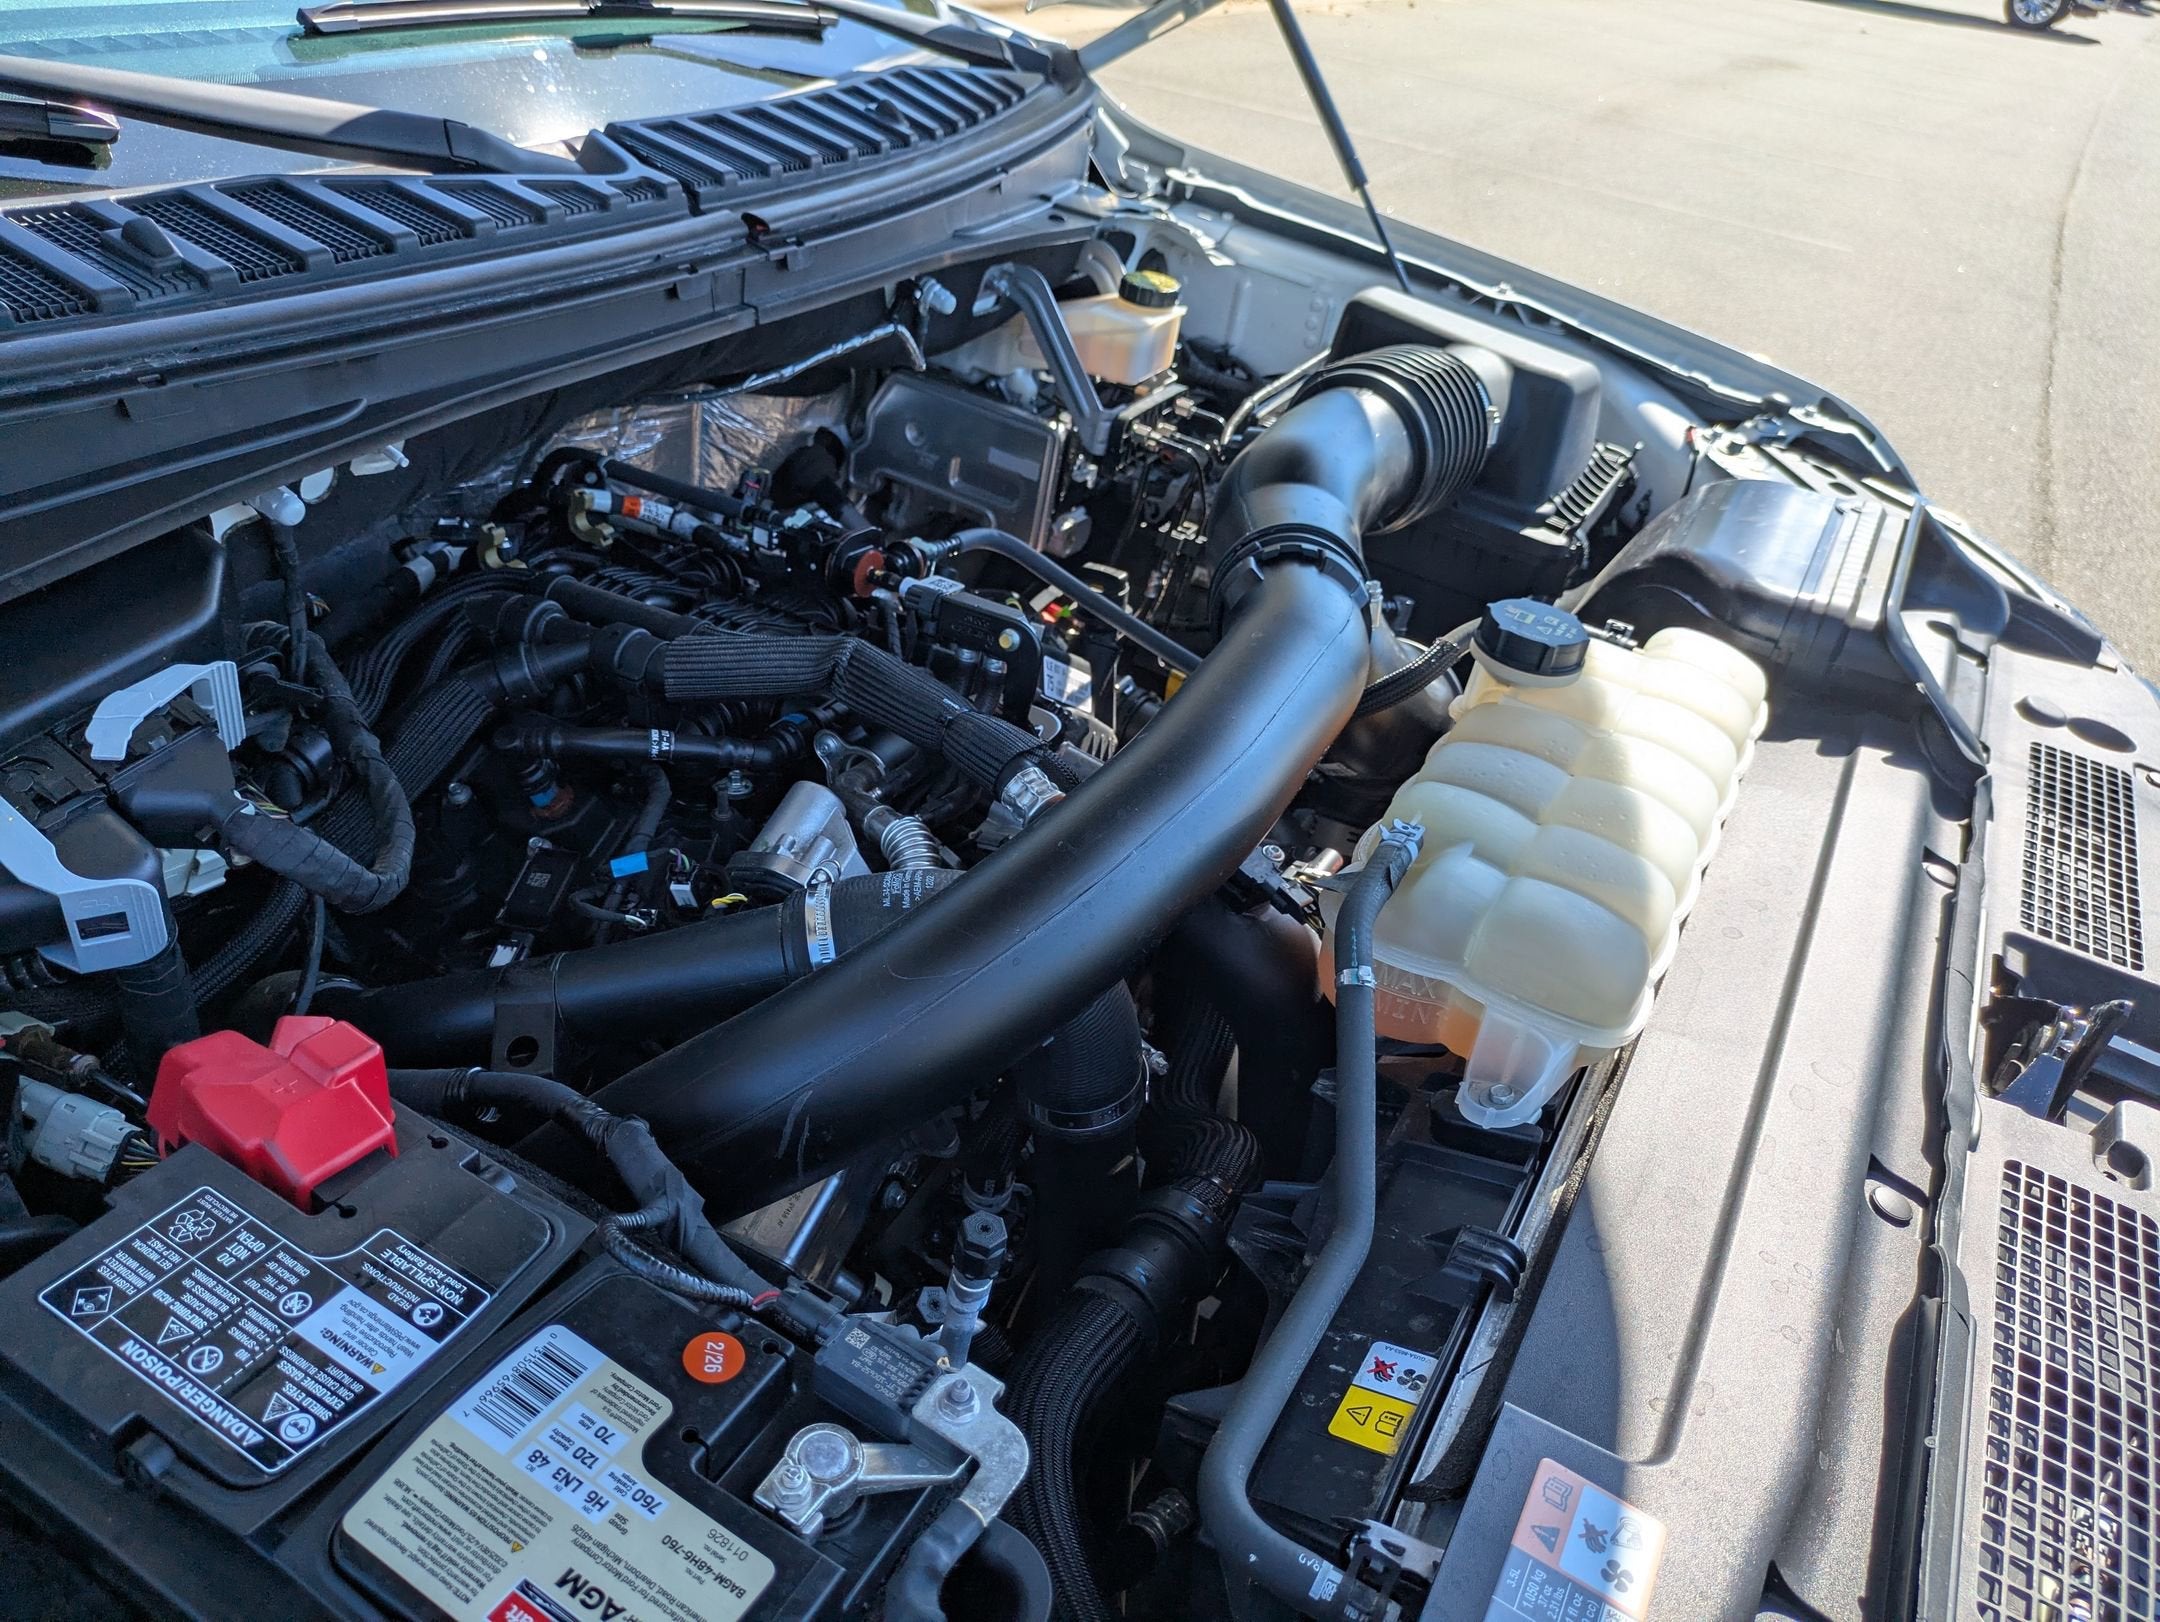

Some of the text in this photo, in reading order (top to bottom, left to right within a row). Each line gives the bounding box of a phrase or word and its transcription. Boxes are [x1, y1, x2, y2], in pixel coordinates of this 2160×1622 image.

[1380, 967, 1438, 999] MAX
[1377, 995, 1429, 1025] MIN
[197, 1198, 234, 1223] BATTERY MUST
[204, 1194, 231, 1212] RECYCLED
[184, 1221, 198, 1231] Pb
[145, 1237, 182, 1262] HELP FAST.
[225, 1241, 251, 1258] NOT
[232, 1228, 266, 1251] OPEN.
[113, 1249, 157, 1280] WITH WATER.
[129, 1239, 173, 1269] GET MEDICAL
[215, 1252, 236, 1265] DO
[273, 1250, 311, 1275] CHILDREN.
[96, 1265, 137, 1294] FLUSH EYES
[102, 1256, 147, 1287] IMMEDIATELY
[265, 1260, 299, 1283] REACH OF
[378, 1248, 464, 1304] NON-SPILLABLE
[394, 1244, 467, 1292] Lead Acid Battery
[189, 1267, 240, 1304] SEVERE BURNS.
[243, 1277, 277, 1300] KEEP OUT
[262, 1274, 288, 1292] OF THE
[358, 1261, 421, 1302] INSTRUCTIONS.
[181, 1277, 229, 1311] BLINDNESS OR
[386, 1292, 412, 1309] READ
[151, 1288, 208, 1329] SULFURIC ACID
[179, 1292, 219, 1320] CAN CAUSE
[238, 1318, 267, 1339] FLAMES
[244, 1307, 278, 1331] SMOKING
[337, 1303, 415, 1357] Wash hands after handling.
[345, 1298, 422, 1349] www.P65Warnings.ca.gov
[227, 1326, 257, 1347] SPARKS
[317, 1327, 376, 1368] WARNING:
[340, 1317, 398, 1357] Reproductive Harm.
[342, 1330, 379, 1355] Cancer and
[233, 1348, 250, 1360] NO
[510, 1346, 543, 1373] 31508
[704, 1342, 725, 1372] 2/26
[278, 1345, 354, 1400] CAN CAUSE BLINDNESS
[324, 1363, 364, 1392] OR INJURY.
[118, 1339, 250, 1437] DANGER/POISON
[276, 1360, 345, 1409] EXPLOSIVE GASES
[477, 1373, 511, 1402] 65966
[633, 1389, 650, 1401] Motor
[279, 1381, 333, 1420] SHIELD EYES.
[596, 1392, 621, 1410] trademark
[617, 1387, 656, 1415] Recommended
[624, 1402, 639, 1413] Motor
[648, 1399, 662, 1409] Ford
[577, 1419, 591, 1430] Amp
[580, 1412, 596, 1425] Hours
[619, 1407, 645, 1426] registered
[637, 1411, 650, 1420] Ford
[548, 1434, 570, 1450] Reserve
[551, 1427, 575, 1445] Capacity
[592, 1425, 616, 1444] 70
[525, 1463, 535, 1471] BCI
[570, 1445, 600, 1468] 120
[526, 1449, 609, 1511] H6 LN3 48
[607, 1471, 633, 1490] Cranking
[620, 1472, 637, 1485] Amps
[613, 1485, 627, 1496] Cold
[630, 1488, 663, 1514] 760
[401, 1508, 412, 1517] see
[581, 1504, 592, 1513] DIN
[613, 1512, 628, 1524] Size
[570, 1523, 594, 1542] 48126
[607, 1518, 629, 1534] Group
[431, 1531, 459, 1552] warranty
[431, 1543, 442, 1553] tag
[569, 1537, 604, 1563] Company
[590, 1538, 624, 1564] Michigan
[702, 1543, 726, 1563] Serial no.
[705, 1528, 749, 1560] 011826
[364, 1518, 472, 1603] NOTE: Keep your receipt. Receipt required
[445, 1555, 460, 1567] void
[455, 1550, 485, 1573] complete
[600, 1560, 624, 1578] Motor
[660, 1534, 747, 1598] BAGM-48H6-760
[457, 1565, 487, 1588] Warranty
[482, 1571, 494, 1581] For
[620, 1561, 657, 1588] Dearborn,
[620, 1575, 639, 1590] Ford
[684, 1567, 705, 1584] Part no.
[1507, 1568, 1520, 1587] 3.5L
[552, 1567, 626, 1622] AGM
[635, 1586, 650, 1599] for
[653, 1585, 677, 1604] Road,
[1523, 1569, 1547, 1608] 1.050 kg
[1538, 1585, 1553, 1607] 37 oz
[1547, 1587, 1565, 1619] 2.31 lbs
